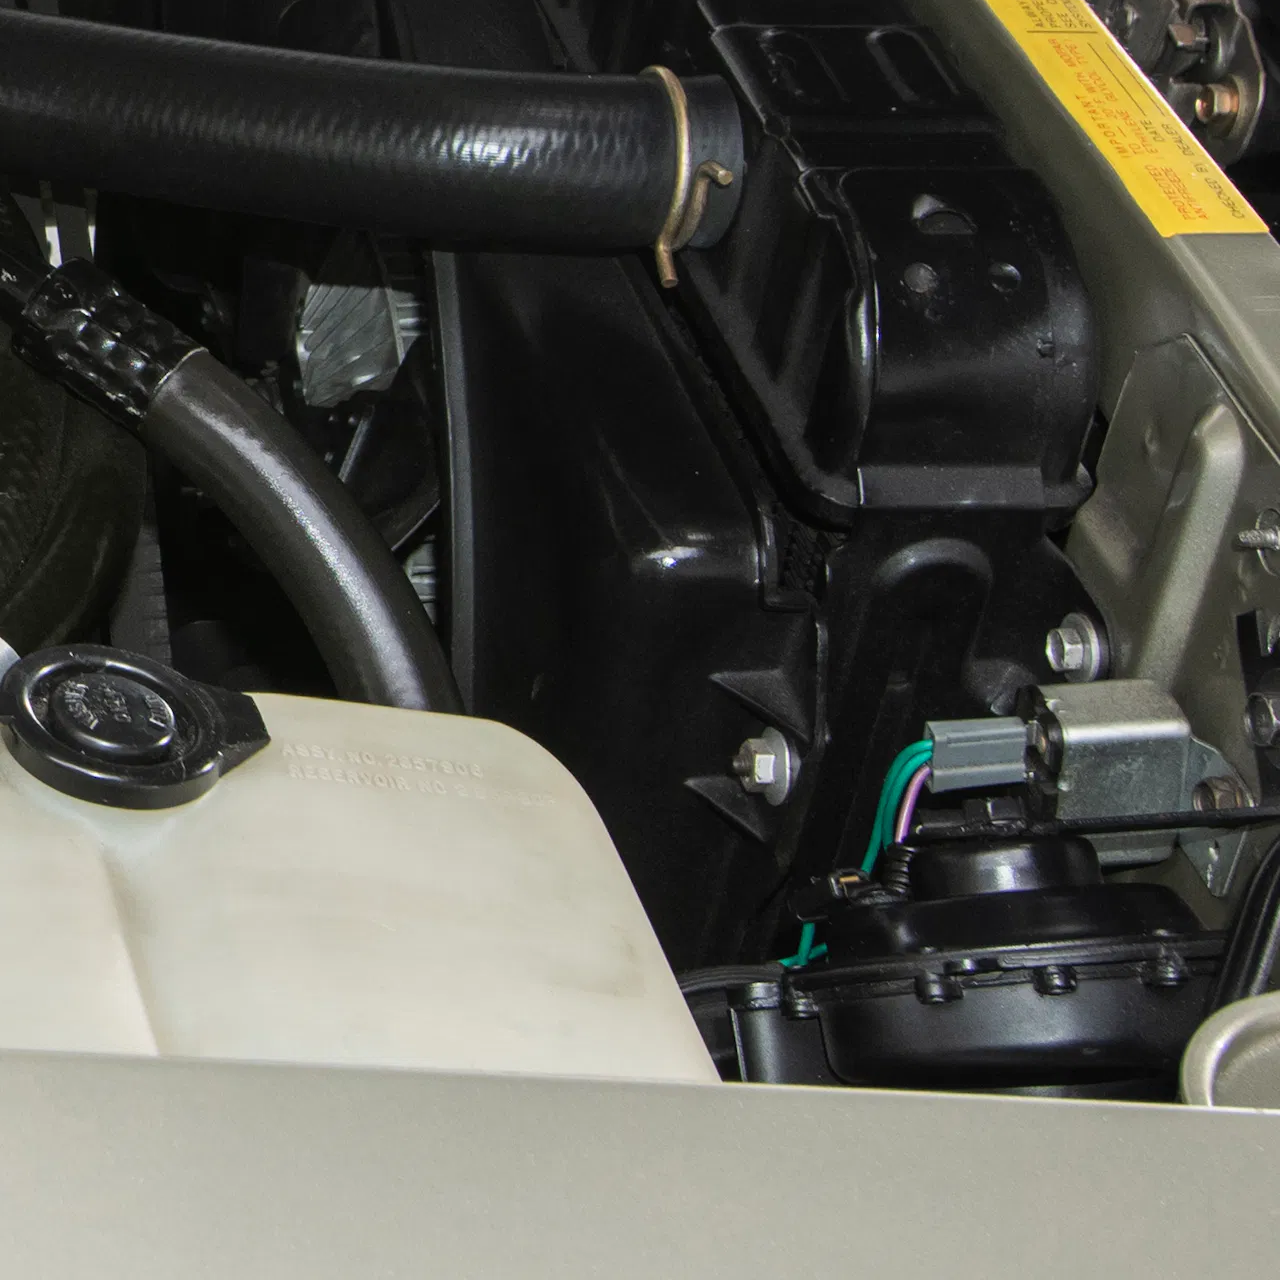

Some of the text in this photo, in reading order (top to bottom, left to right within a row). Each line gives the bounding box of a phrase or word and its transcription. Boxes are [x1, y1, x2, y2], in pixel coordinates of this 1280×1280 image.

[1076, 94, 1130, 158] IMPORTANT
[1140, 119, 1163, 141] DATE
[1144, 164, 1194, 220] PROTECTED
[287, 764, 410, 791] RESERVOIR
